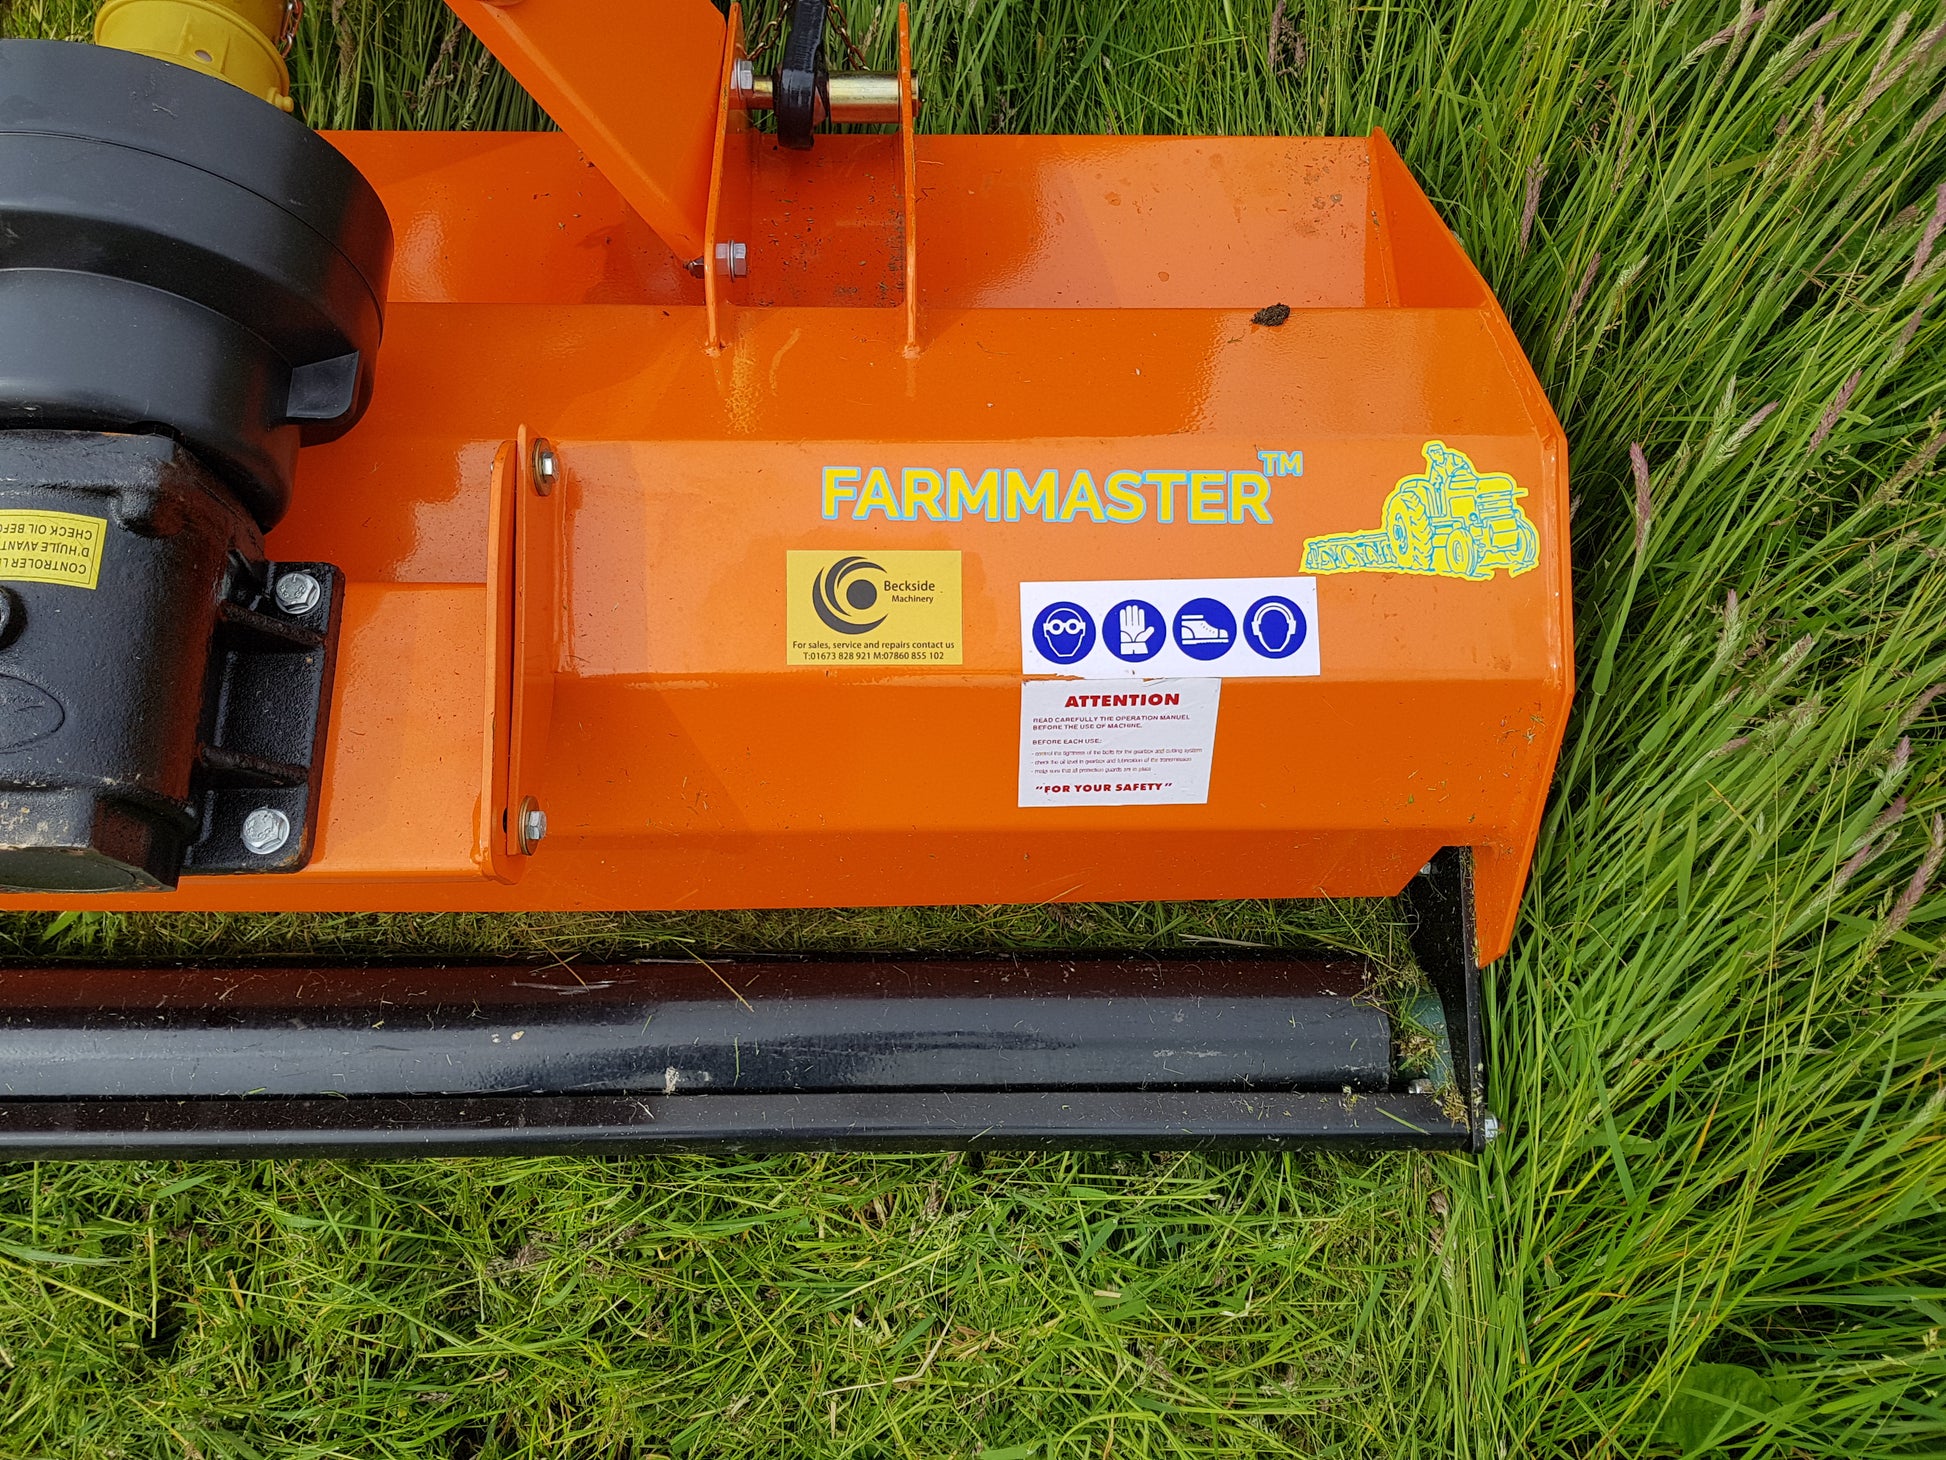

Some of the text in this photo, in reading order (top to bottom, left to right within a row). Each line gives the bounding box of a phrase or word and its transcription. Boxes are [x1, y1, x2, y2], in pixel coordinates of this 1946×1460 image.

[822, 451, 1303, 523] FARMMASTER TM
[28, 524, 47, 534] OIL
[50, 526, 92, 540] CHECK
[0, 540, 89, 558] D'HUILE AVANT
[11, 558, 86, 574] CONTROLER
[884, 580, 935, 592] Beckside
[892, 595, 934, 604] Machinery
[793, 641, 807, 649] For
[808, 641, 831, 650] sales,
[833, 641, 862, 649] service
[864, 641, 879, 649] and
[882, 641, 910, 651] repairs
[912, 641, 944, 649] contact
[804, 652, 836, 660] T:01673
[873, 652, 909, 660] M:07860
[1064, 694, 1180, 707] ATTENTION
[1074, 784, 1112, 792] YOUR
